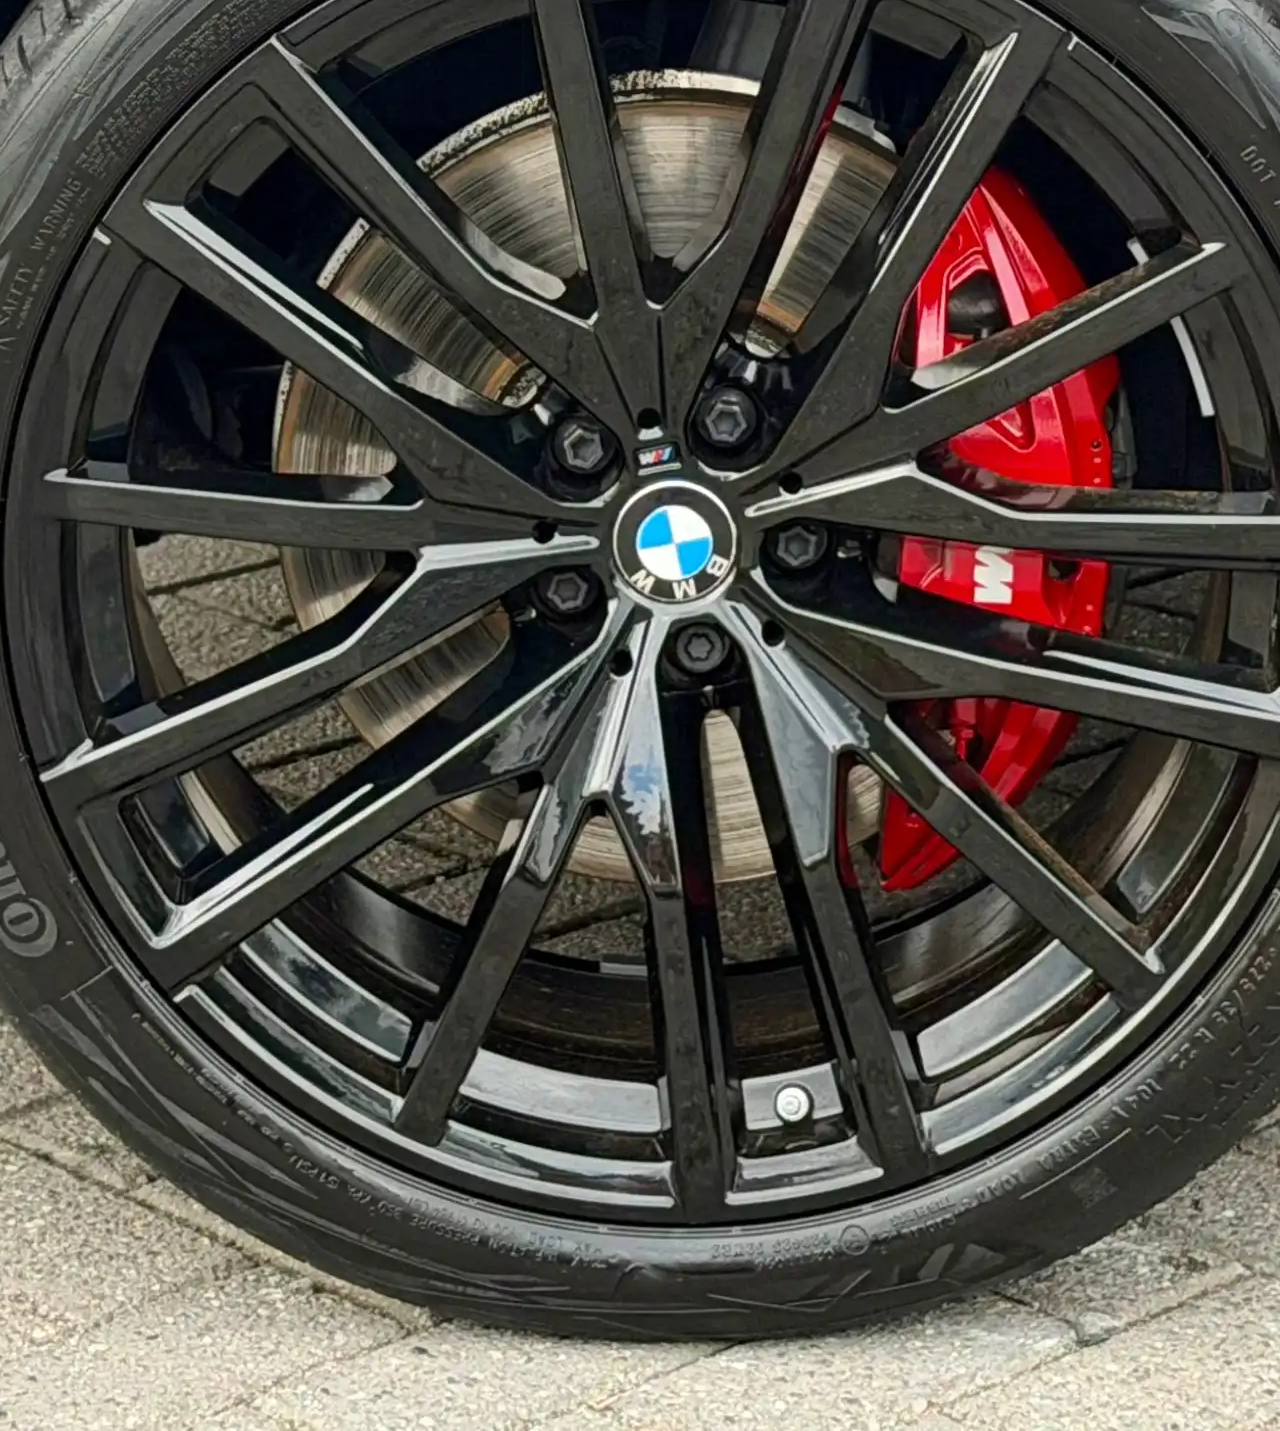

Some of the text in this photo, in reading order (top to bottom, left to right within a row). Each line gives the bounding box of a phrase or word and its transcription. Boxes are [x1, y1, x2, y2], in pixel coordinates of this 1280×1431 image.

[1239, 144, 1277, 183] DOT
[29, 177, 81, 253] WARNING
[630, 554, 729, 600] BMW
[973, 545, 1014, 604] M
